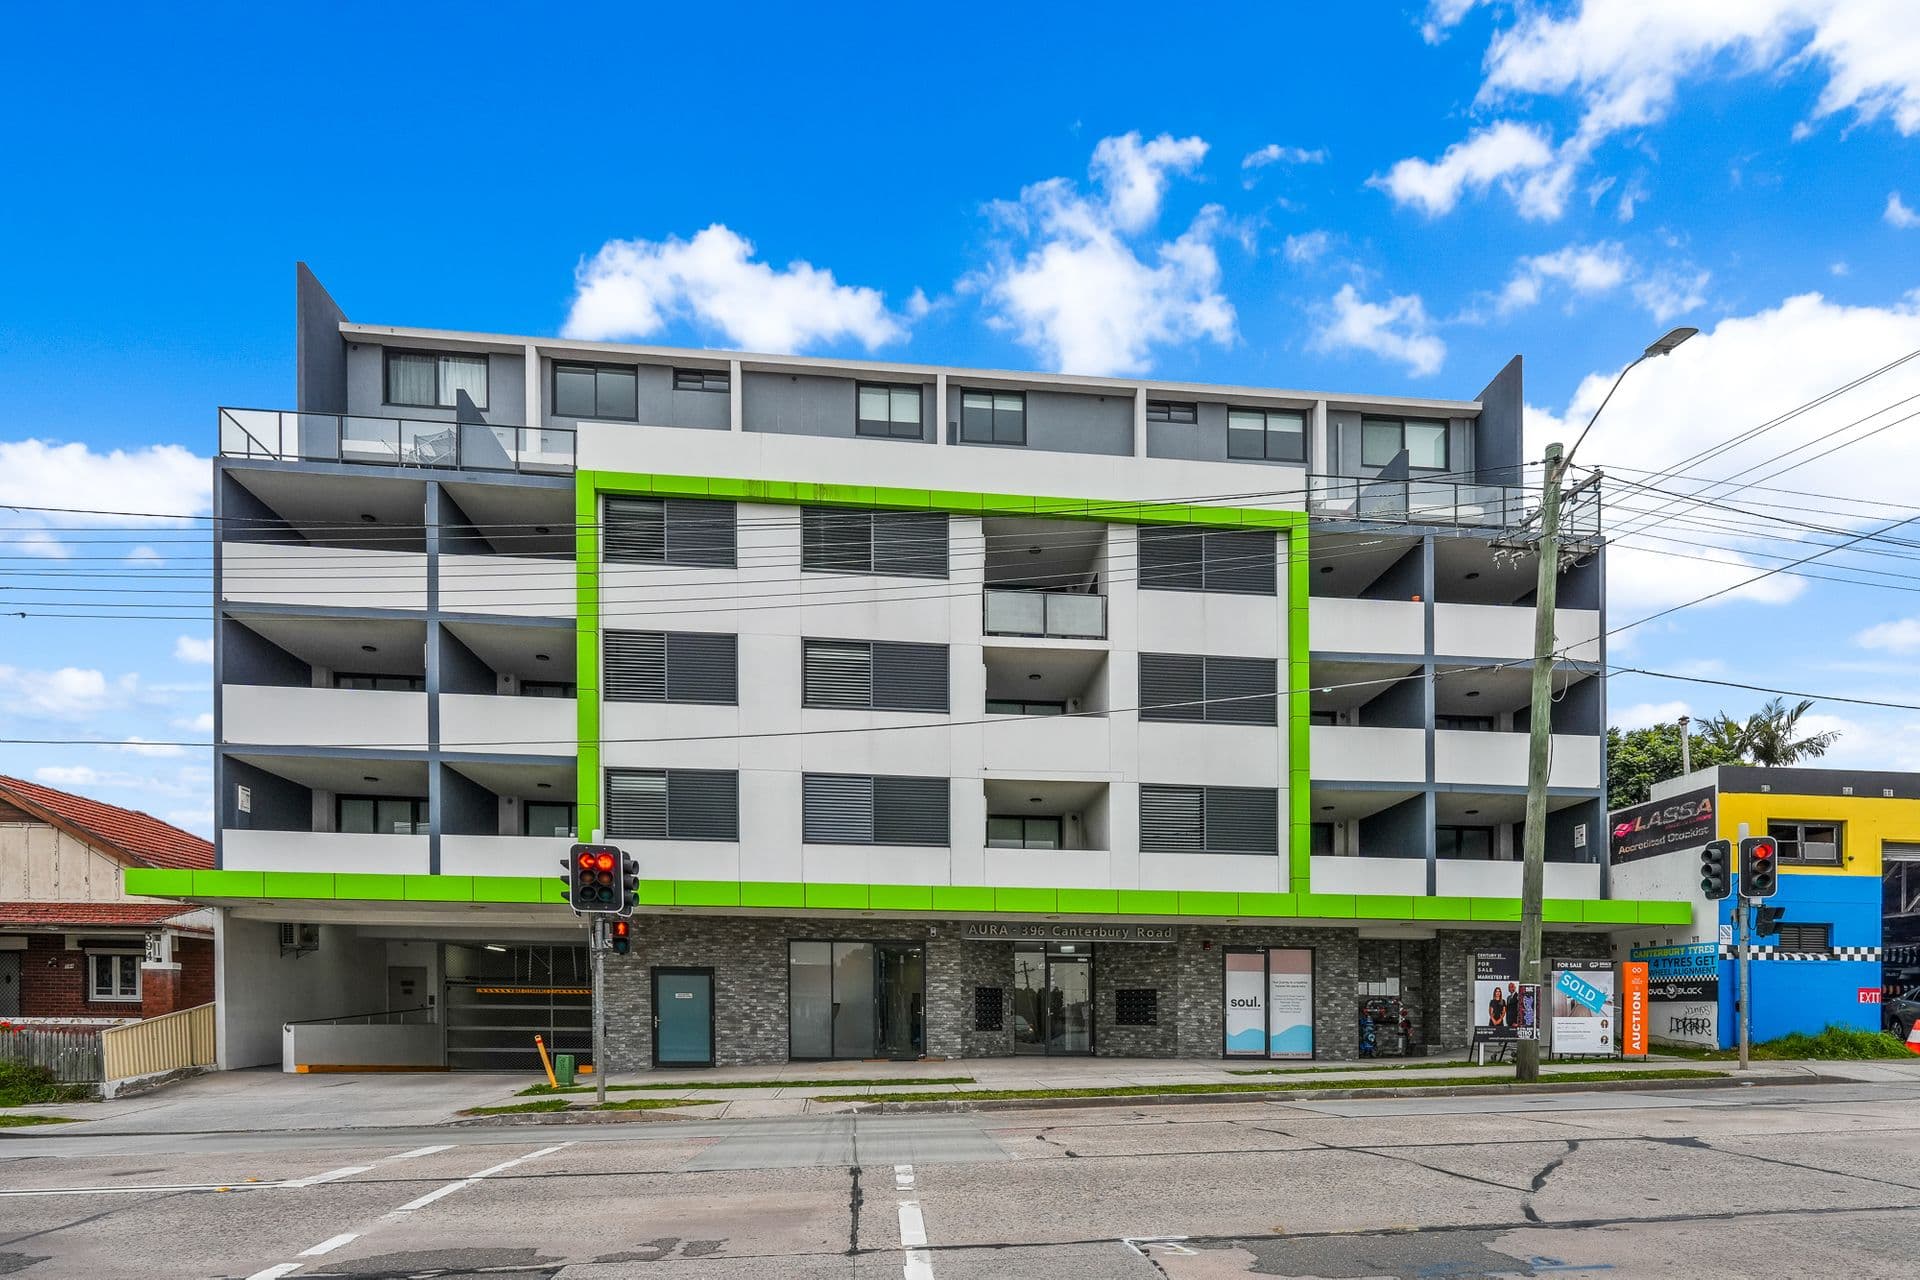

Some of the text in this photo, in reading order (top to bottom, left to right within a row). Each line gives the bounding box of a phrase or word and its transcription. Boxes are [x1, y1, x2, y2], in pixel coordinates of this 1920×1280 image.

[1634, 798, 1712, 832] LASSA
[968, 924, 1008, 935] AURA
[1022, 925, 1045, 936] 396
[1052, 925, 1129, 939] Canterbury
[1137, 927, 1172, 938] Road
[145, 931, 153, 961] 394
[1633, 945, 1715, 958] CANTERBURY TYRES
[1662, 956, 1693, 968] TYRES
[1695, 955, 1716, 966] GET
[1673, 966, 1717, 976] ALIGNMENT
[1561, 974, 1596, 1001] SOLD
[1230, 996, 1261, 1008] soul.
[1859, 991, 1881, 1003] EXIT
[1632, 991, 1641, 1051] AUCTION
